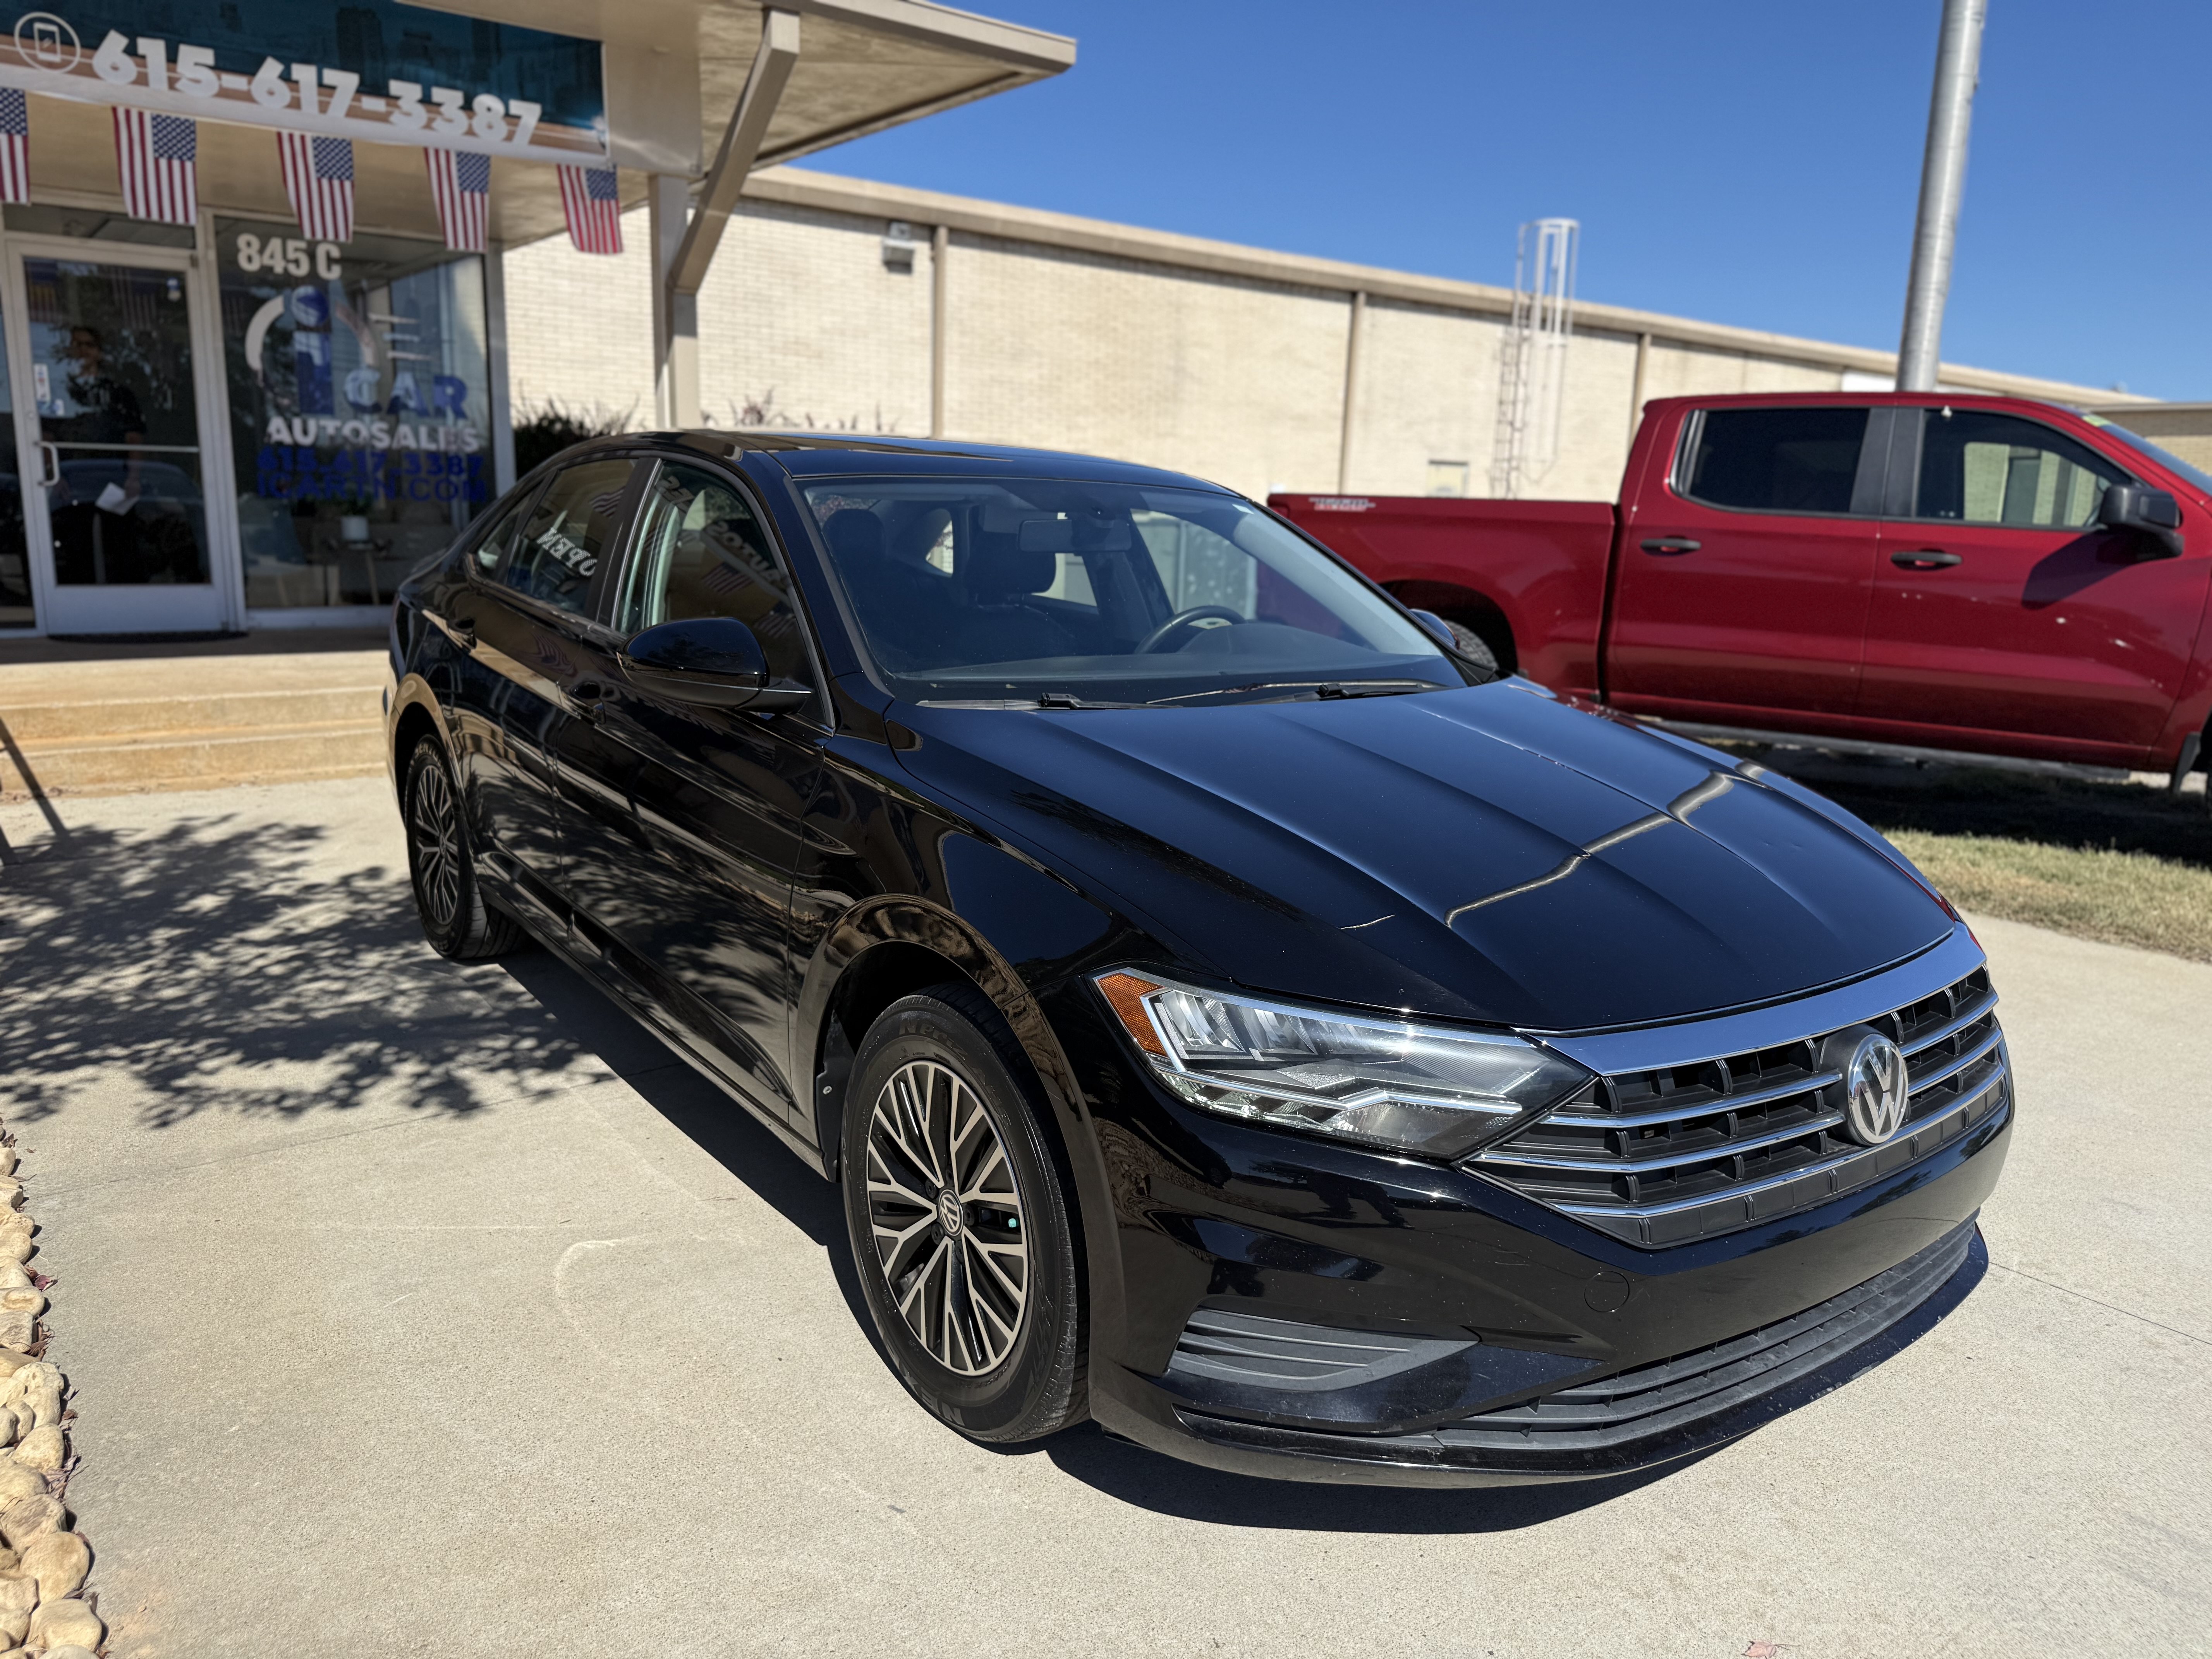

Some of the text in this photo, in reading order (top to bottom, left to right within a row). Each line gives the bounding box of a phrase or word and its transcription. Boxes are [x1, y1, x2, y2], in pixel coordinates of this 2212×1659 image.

[92, 29, 542, 145] 615-617-3387
[237, 233, 342, 280] 845 C
[256, 471, 487, 504] ICARTN.COM
[1848, 1033, 1908, 1144] VW
